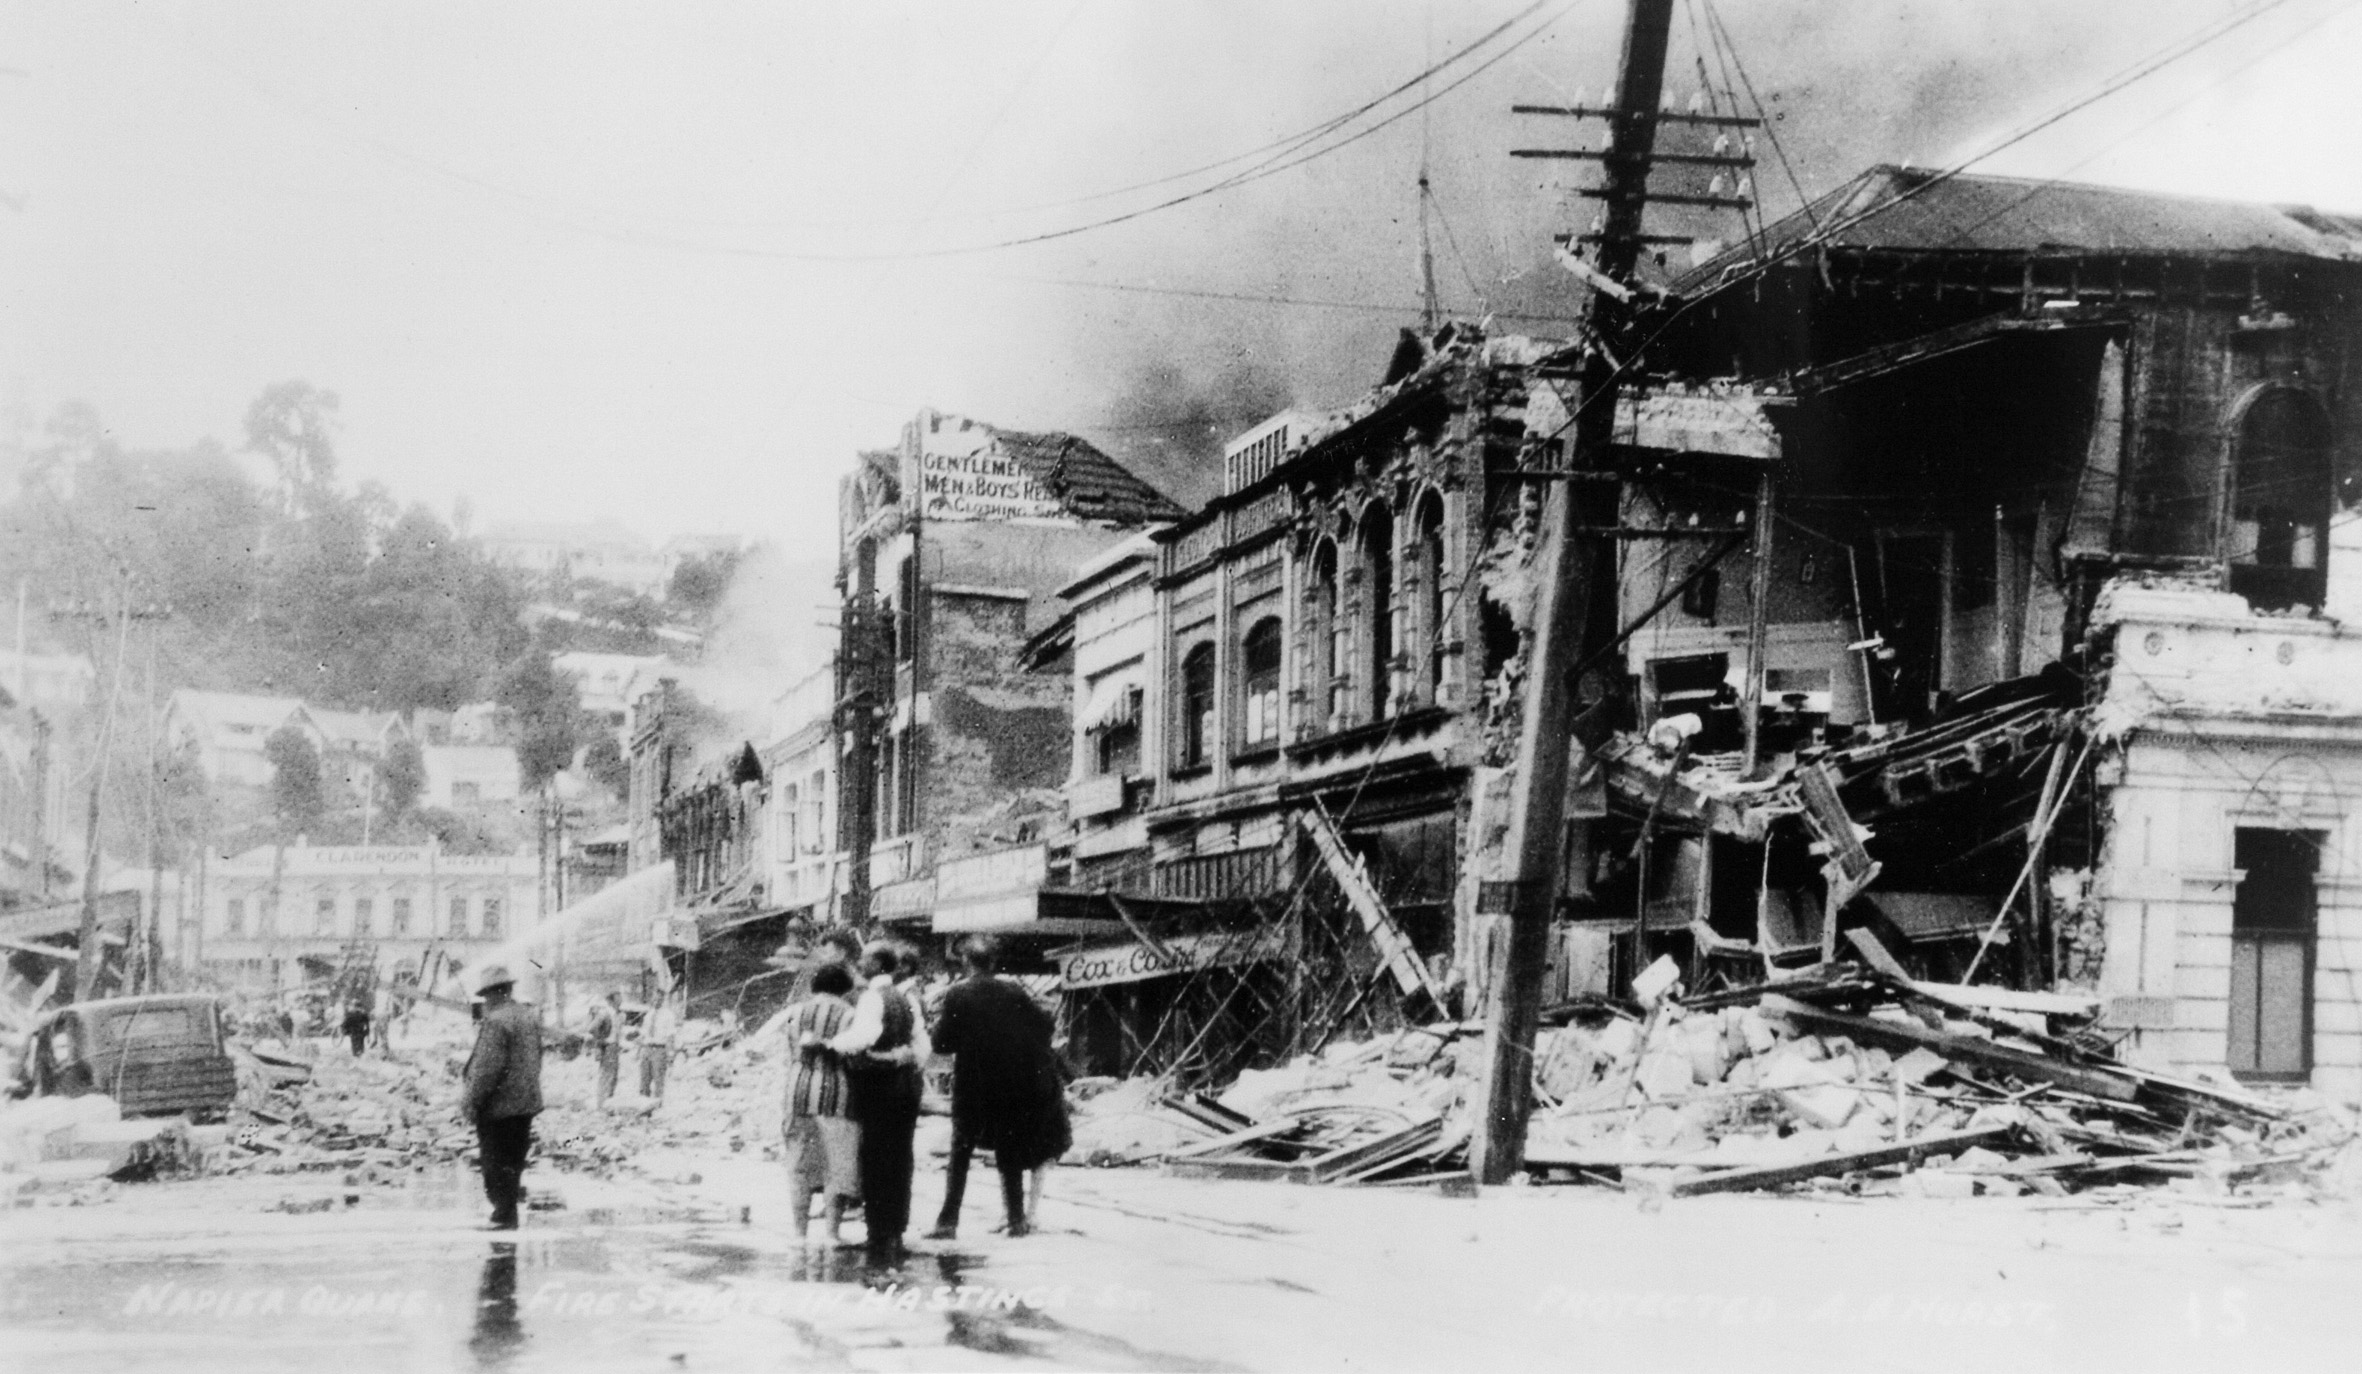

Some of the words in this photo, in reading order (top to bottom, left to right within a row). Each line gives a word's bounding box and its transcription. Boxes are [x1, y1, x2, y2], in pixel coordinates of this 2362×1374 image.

[924, 474, 964, 494] MEN
[315, 851, 420, 863] CLARENDON
[1066, 955, 1113, 984] Cox
